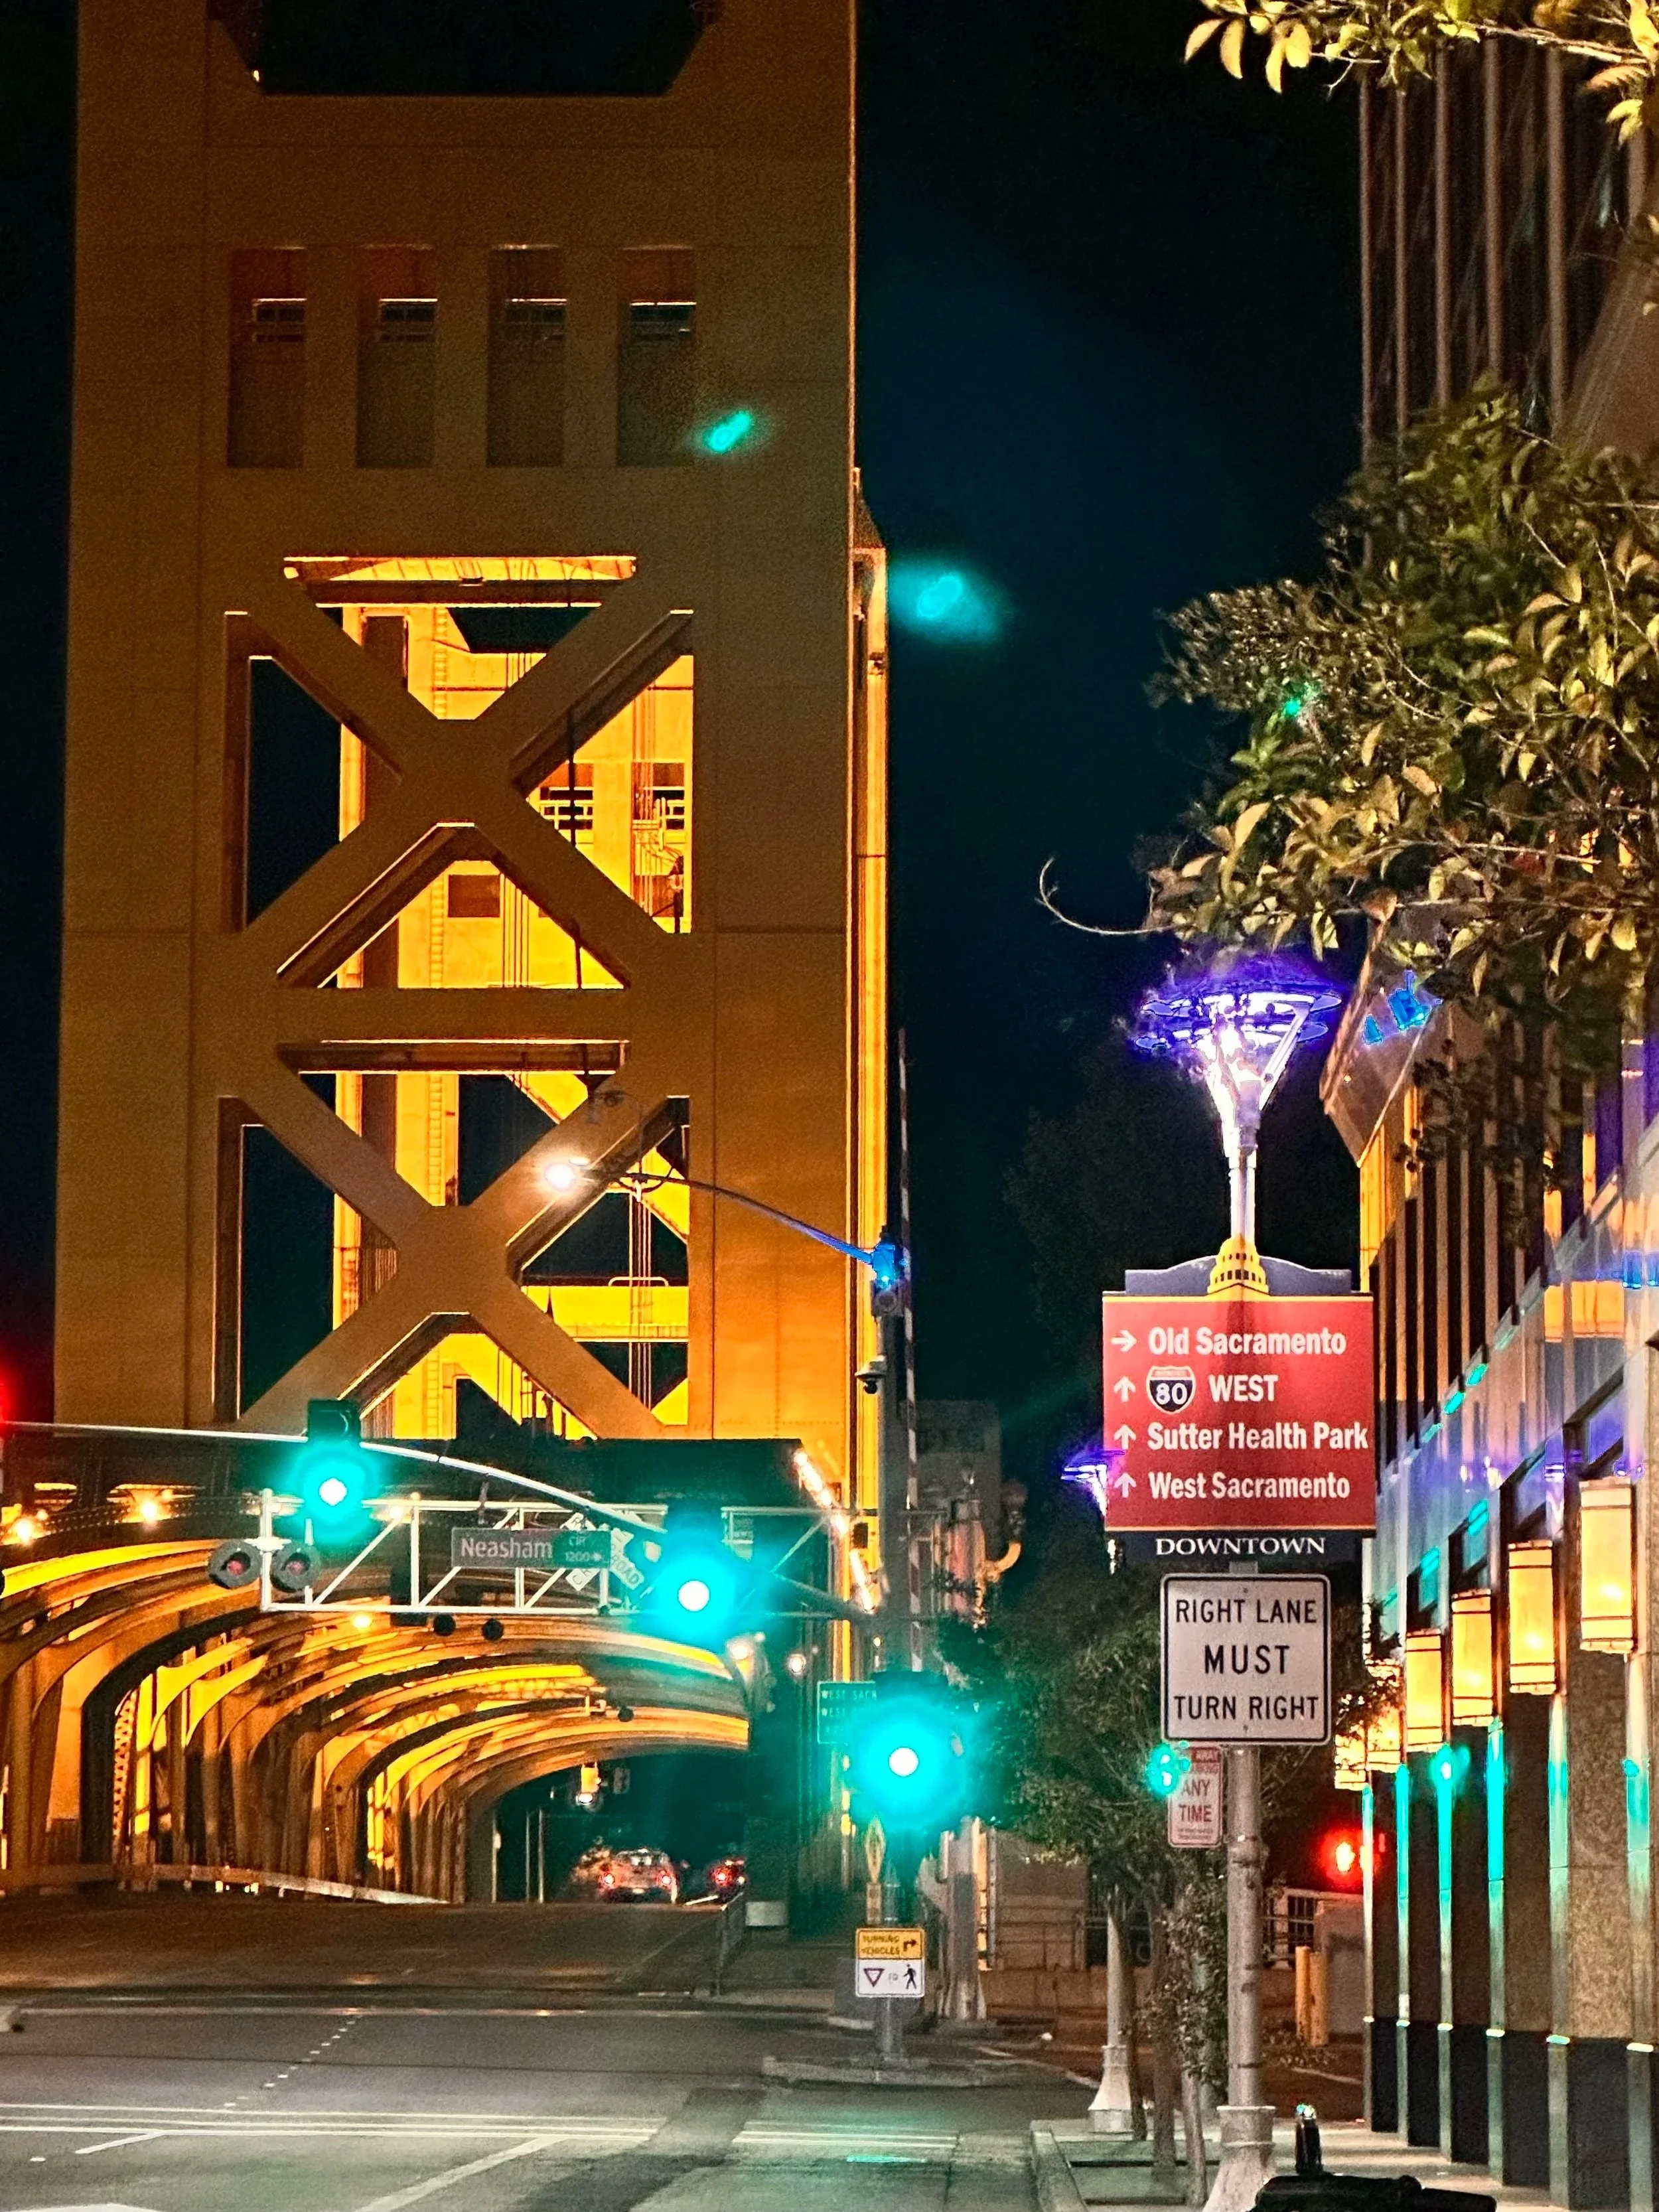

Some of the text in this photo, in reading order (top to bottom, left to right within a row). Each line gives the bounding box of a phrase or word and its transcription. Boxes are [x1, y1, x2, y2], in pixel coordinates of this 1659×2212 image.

[1149, 1327, 1346, 1355] Old Sacramento
[1156, 1374, 1279, 1405] 80 WEST
[1148, 1422, 1369, 1450] Sutter Health Park
[1149, 1471, 1350, 1499] West Sacramento
[461, 1538, 553, 1558] Neasham
[1155, 1538, 1326, 1555] DOWNTOWN
[1176, 1599, 1317, 1623] RIGHT LANE
[1204, 1645, 1289, 1674] MUST
[1174, 1696, 1319, 1720] TURN RIGHT
[1181, 1779, 1210, 1797] ANY
[1179, 1805, 1212, 1822] TIME
